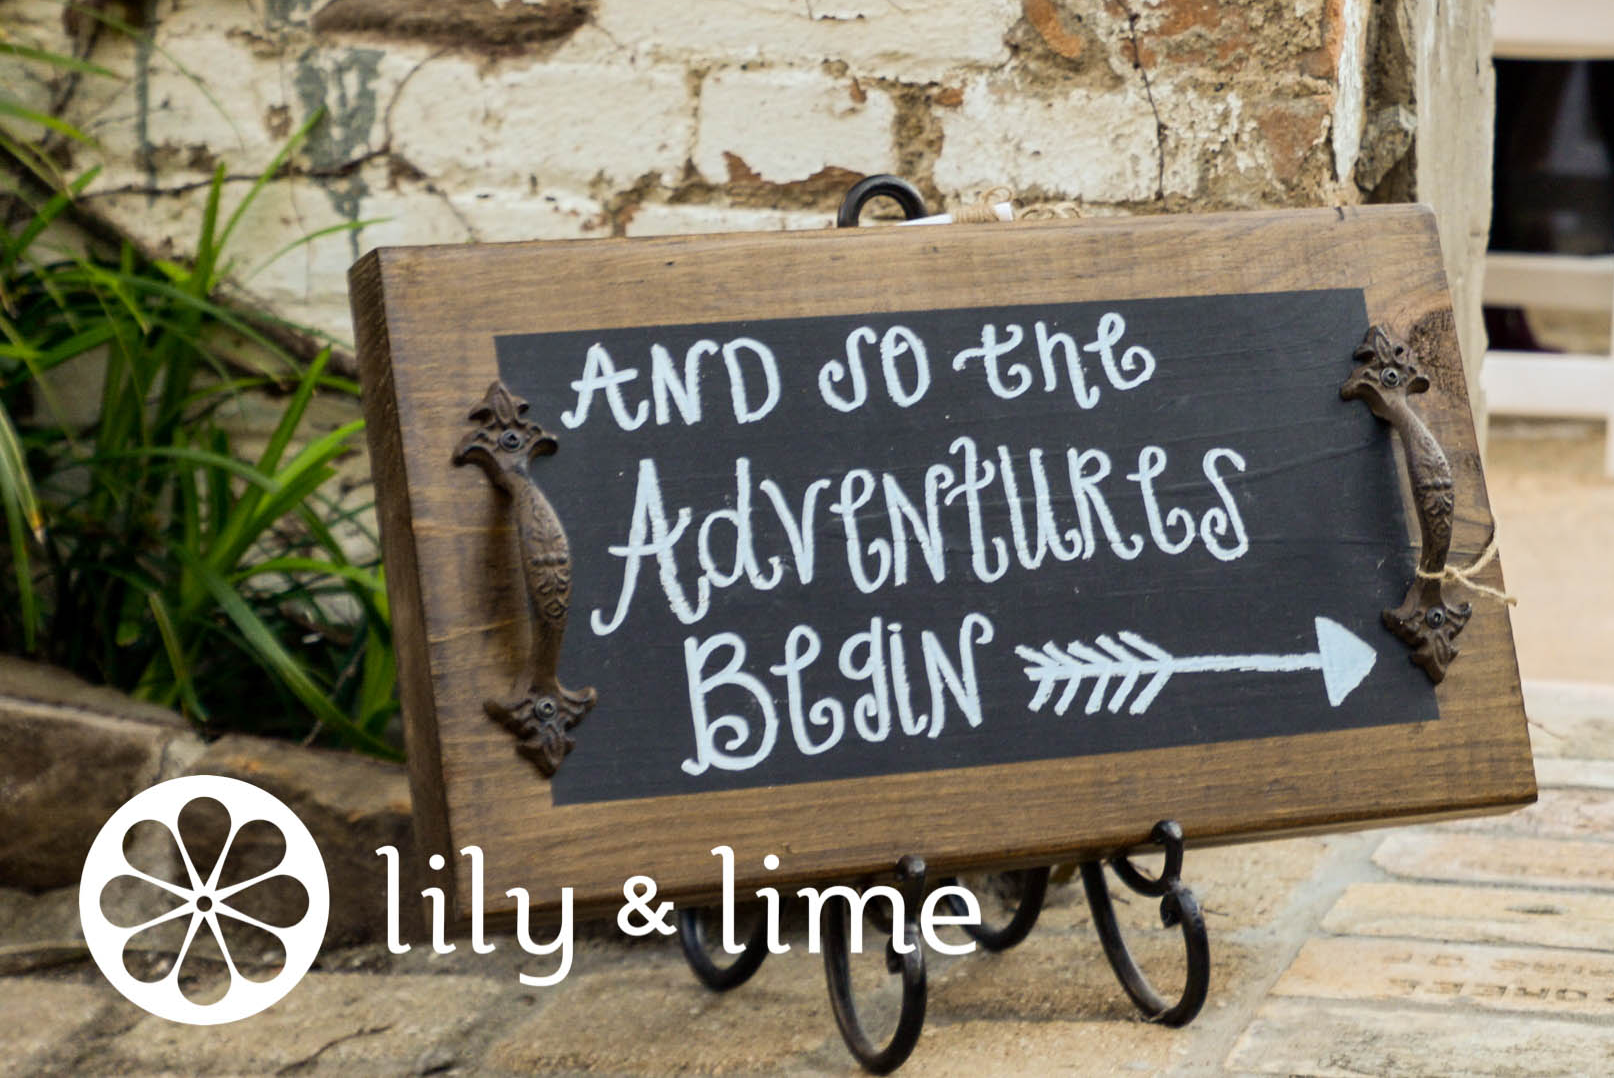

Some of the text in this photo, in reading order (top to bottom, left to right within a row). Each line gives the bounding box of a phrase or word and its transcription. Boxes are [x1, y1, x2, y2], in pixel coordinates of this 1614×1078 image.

[560, 312, 1157, 432] AND SO the
